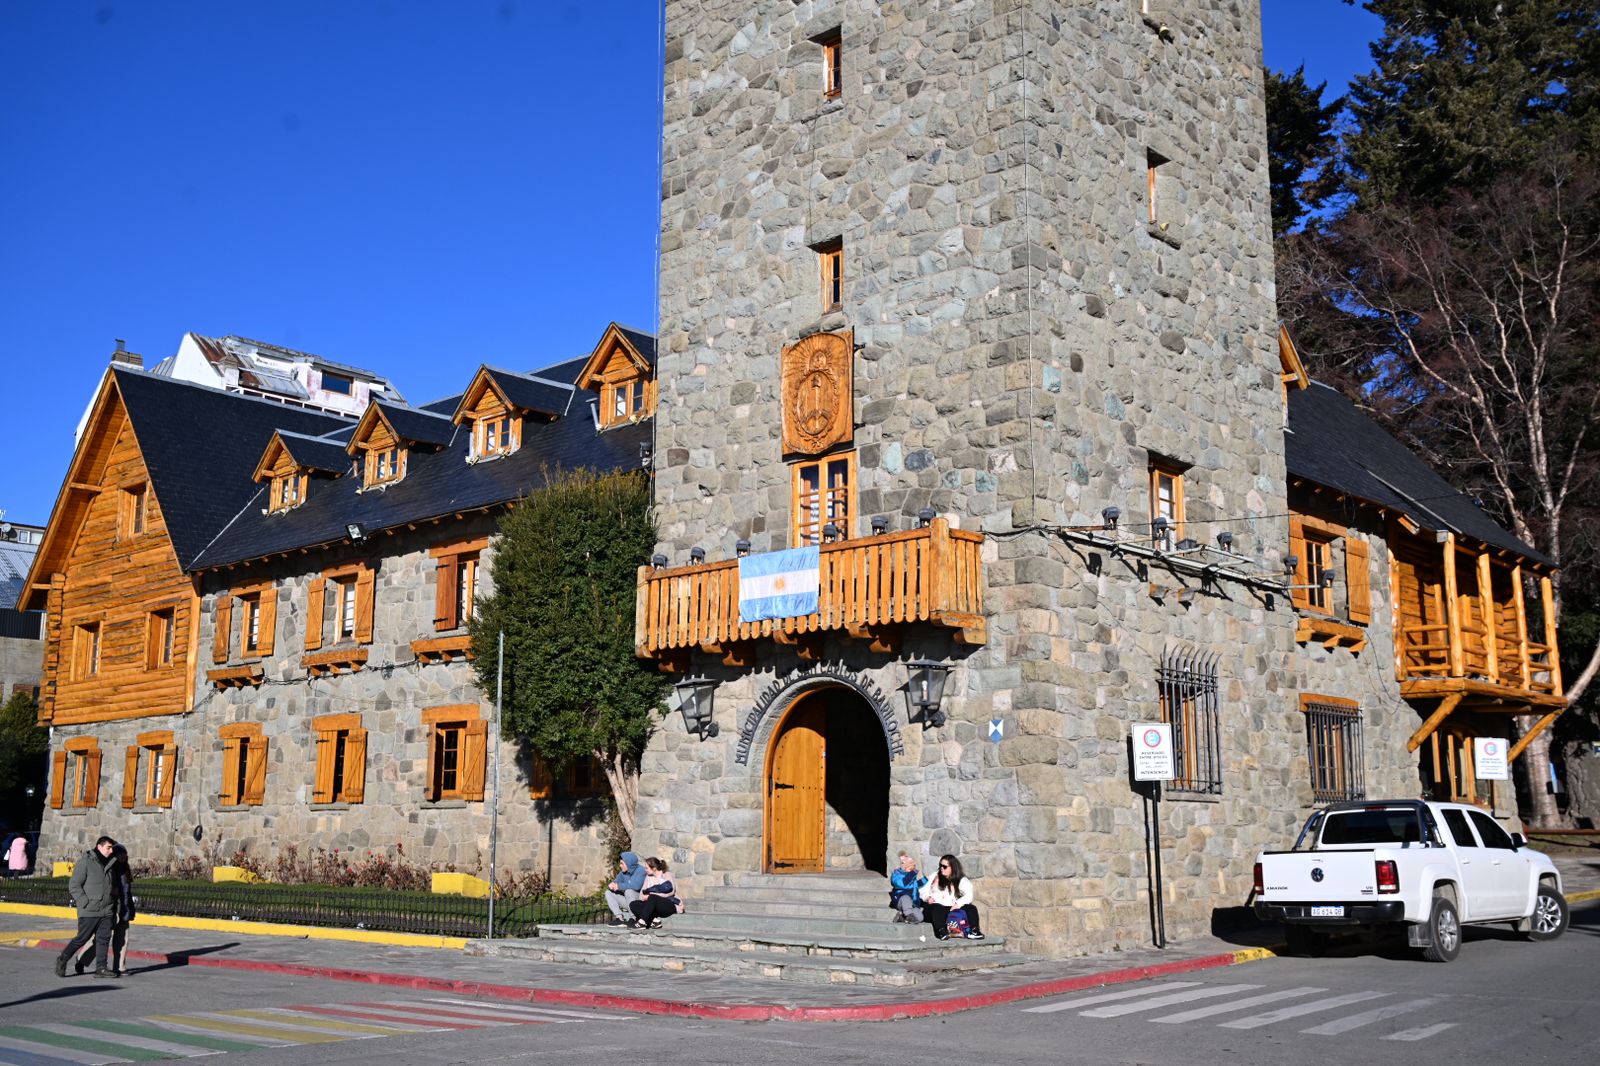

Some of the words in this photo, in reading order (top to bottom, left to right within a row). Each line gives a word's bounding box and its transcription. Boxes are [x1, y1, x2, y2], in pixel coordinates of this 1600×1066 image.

[735, 680, 781, 766] MUNICIPALIDAD
[861, 675, 875, 691] DE
[871, 687, 904, 761] BARILOCHE
